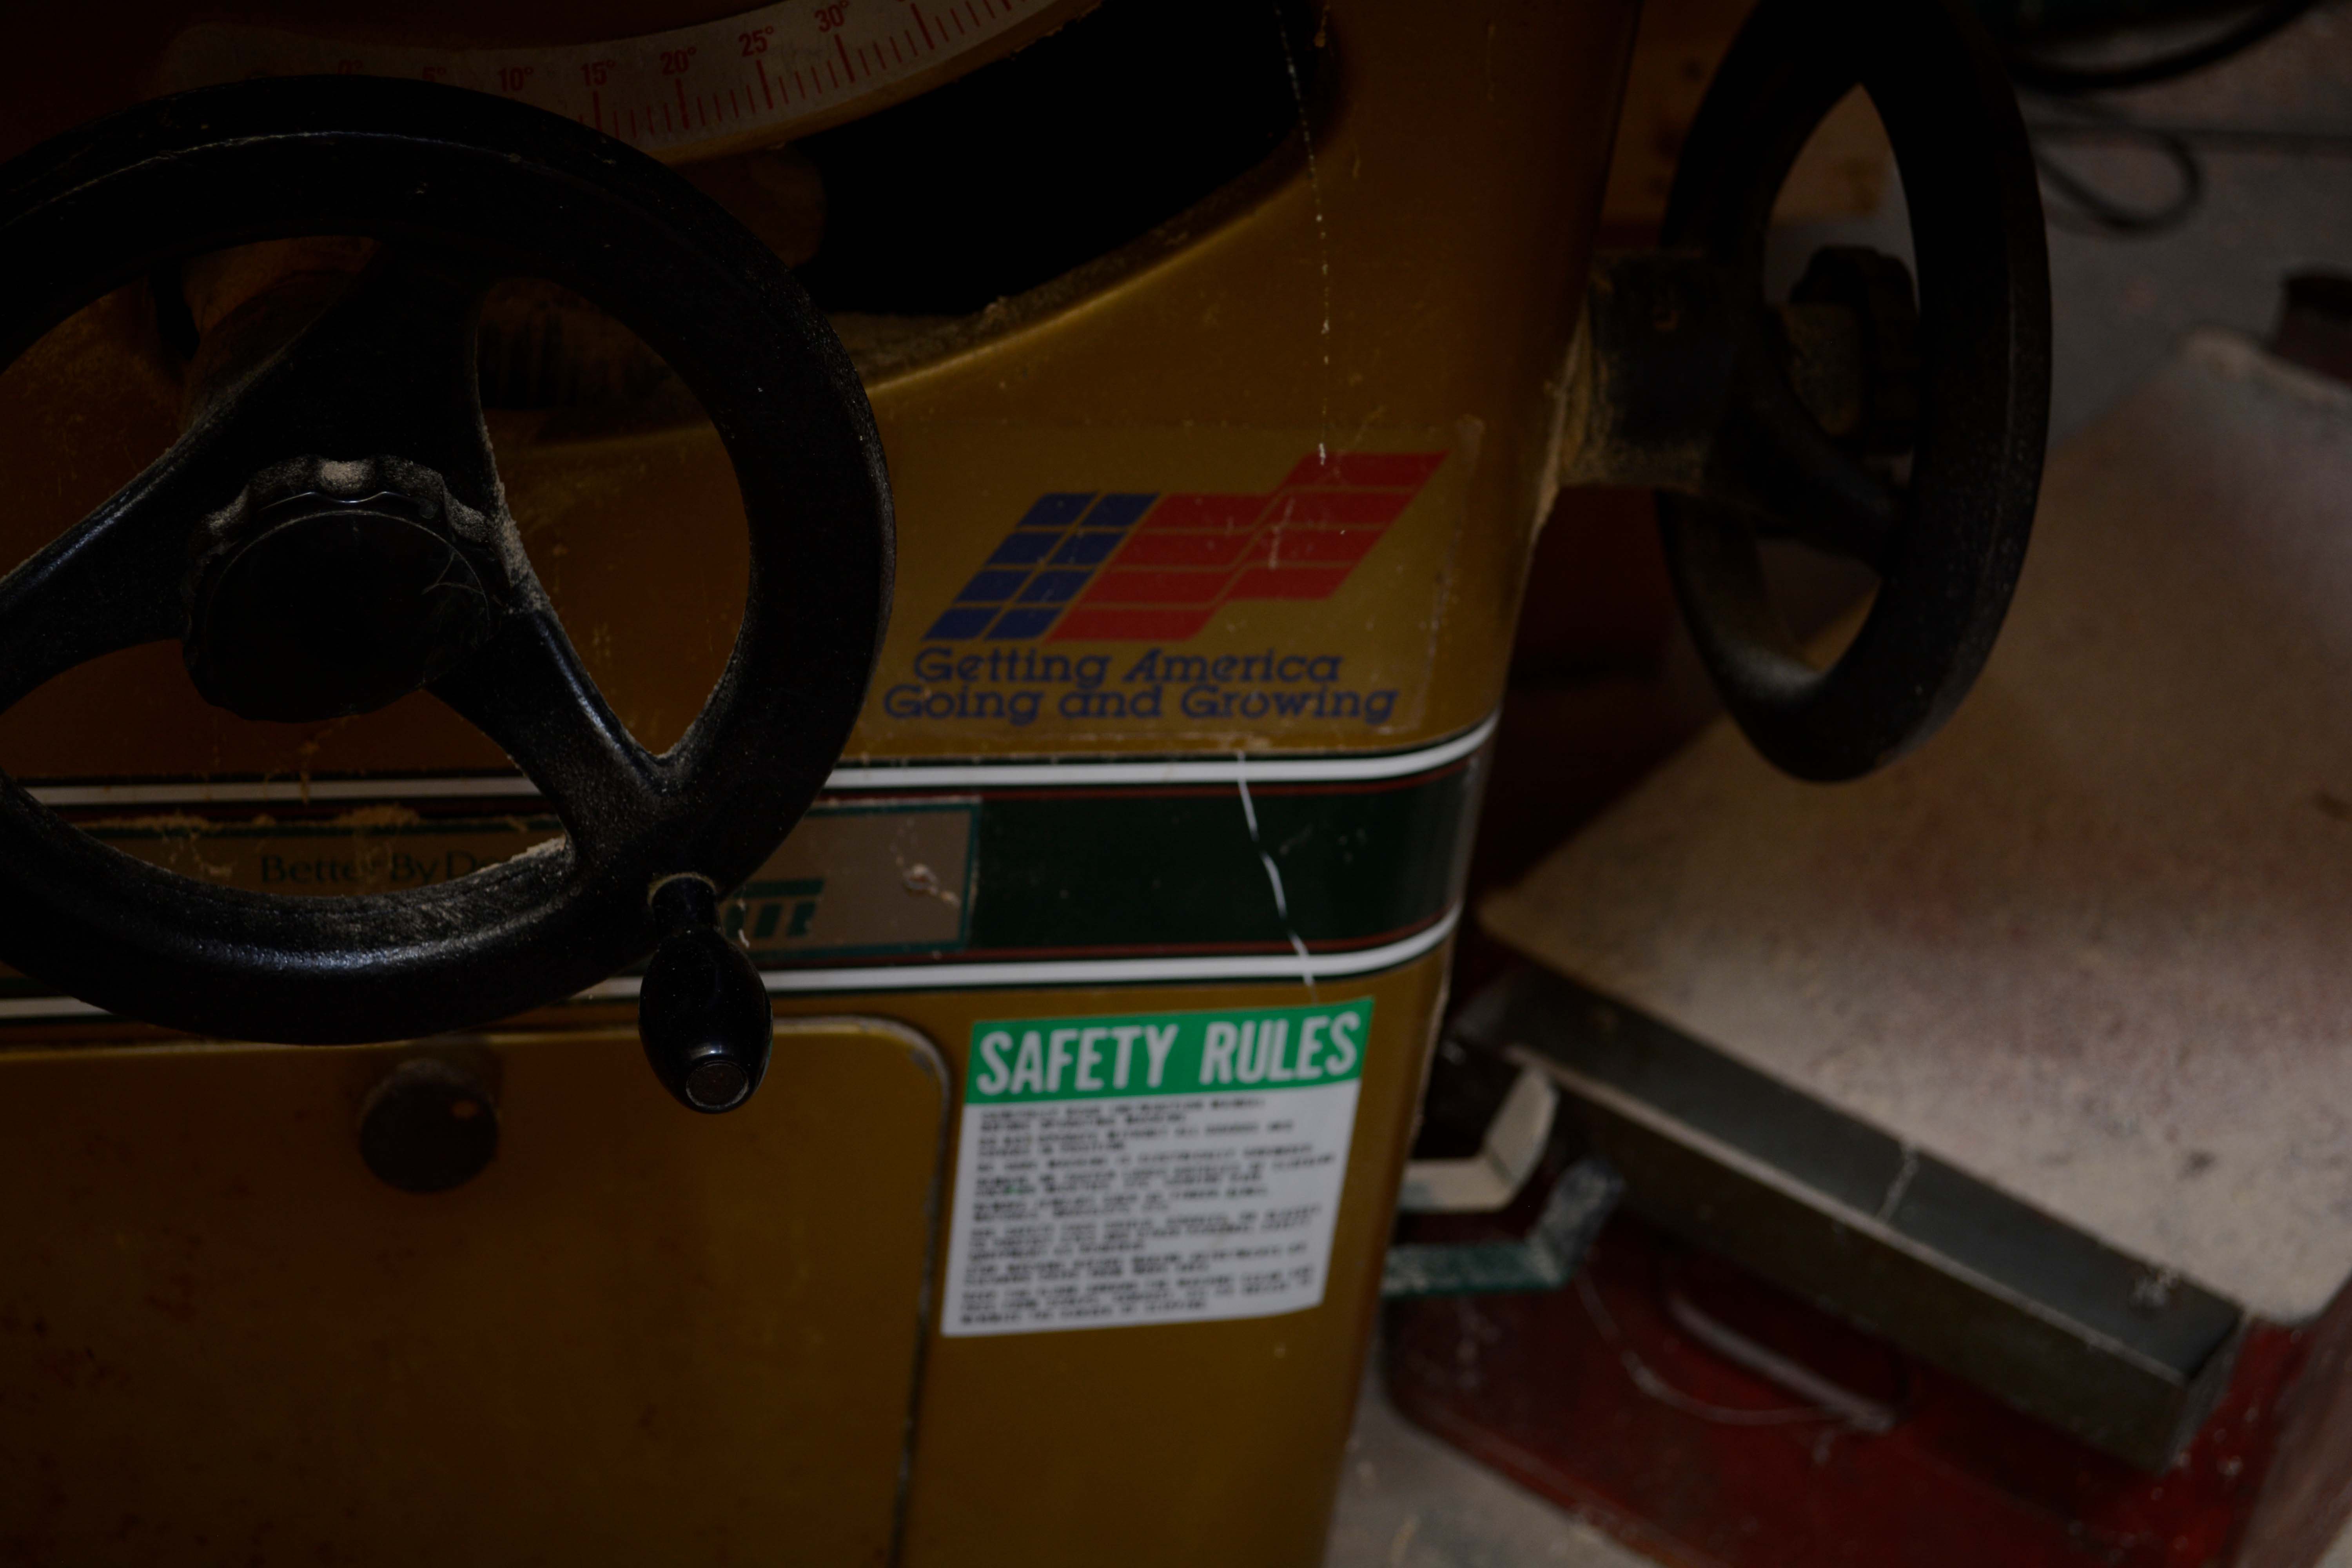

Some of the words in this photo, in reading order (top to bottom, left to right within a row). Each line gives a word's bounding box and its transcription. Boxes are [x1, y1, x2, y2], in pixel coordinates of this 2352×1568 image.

[498, 66, 534, 91] 10°
[581, 60, 615, 86] 15°
[660, 47, 697, 75] 20°
[739, 26, 774, 56] 25°
[814, 0, 849, 32] 30°
[914, 647, 1111, 689] Getting
[1123, 648, 1341, 684] America
[884, 683, 1044, 726] Going
[1059, 685, 1162, 719] and
[1181, 685, 1399, 725] Growing
[262, 855, 372, 884] Bette
[391, 851, 437, 887] By
[975, 1024, 1179, 1096] SAFETY
[1198, 1010, 1362, 1085] RULES
